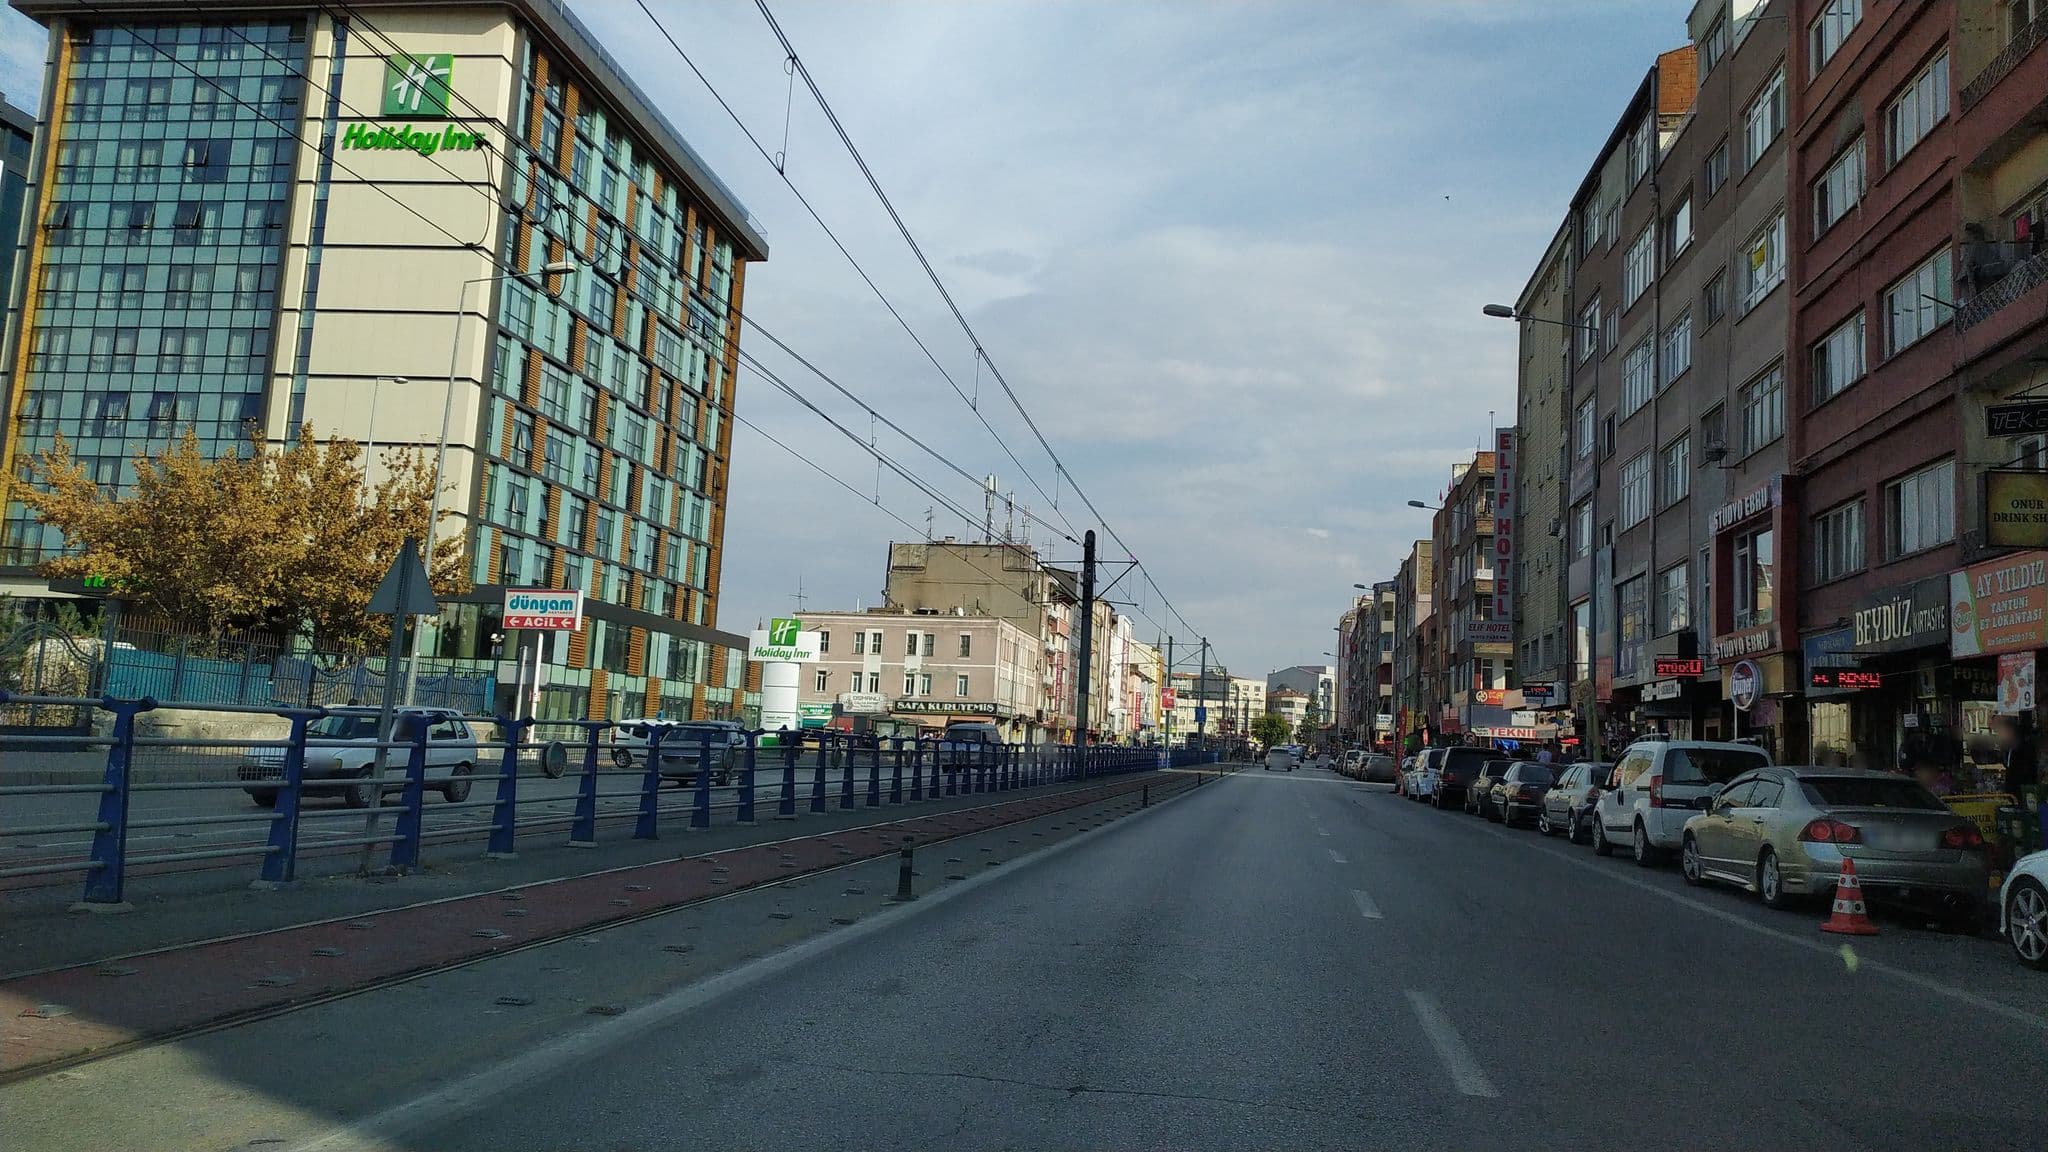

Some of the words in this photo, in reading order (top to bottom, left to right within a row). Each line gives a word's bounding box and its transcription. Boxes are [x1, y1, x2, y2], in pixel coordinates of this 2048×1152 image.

[342, 124, 441, 156] Holiday
[1744, 487, 1767, 516] EBRU
[2010, 499, 2044, 509] ONUR
[1993, 512, 2029, 523] DRINK
[1497, 518, 1511, 617] HOTEL
[1976, 573, 1992, 598] AY
[1995, 560, 2046, 593] YILDIZ
[509, 595, 573, 614] dünyam
[1486, 623, 1510, 632] HOTEL
[1855, 596, 1912, 647] BEYDÜZ
[1992, 608, 2042, 628] LOKANTASI
[1745, 631, 1769, 653] EBRU
[754, 646, 793, 660] Holiday
[793, 647, 810, 658] Inn
